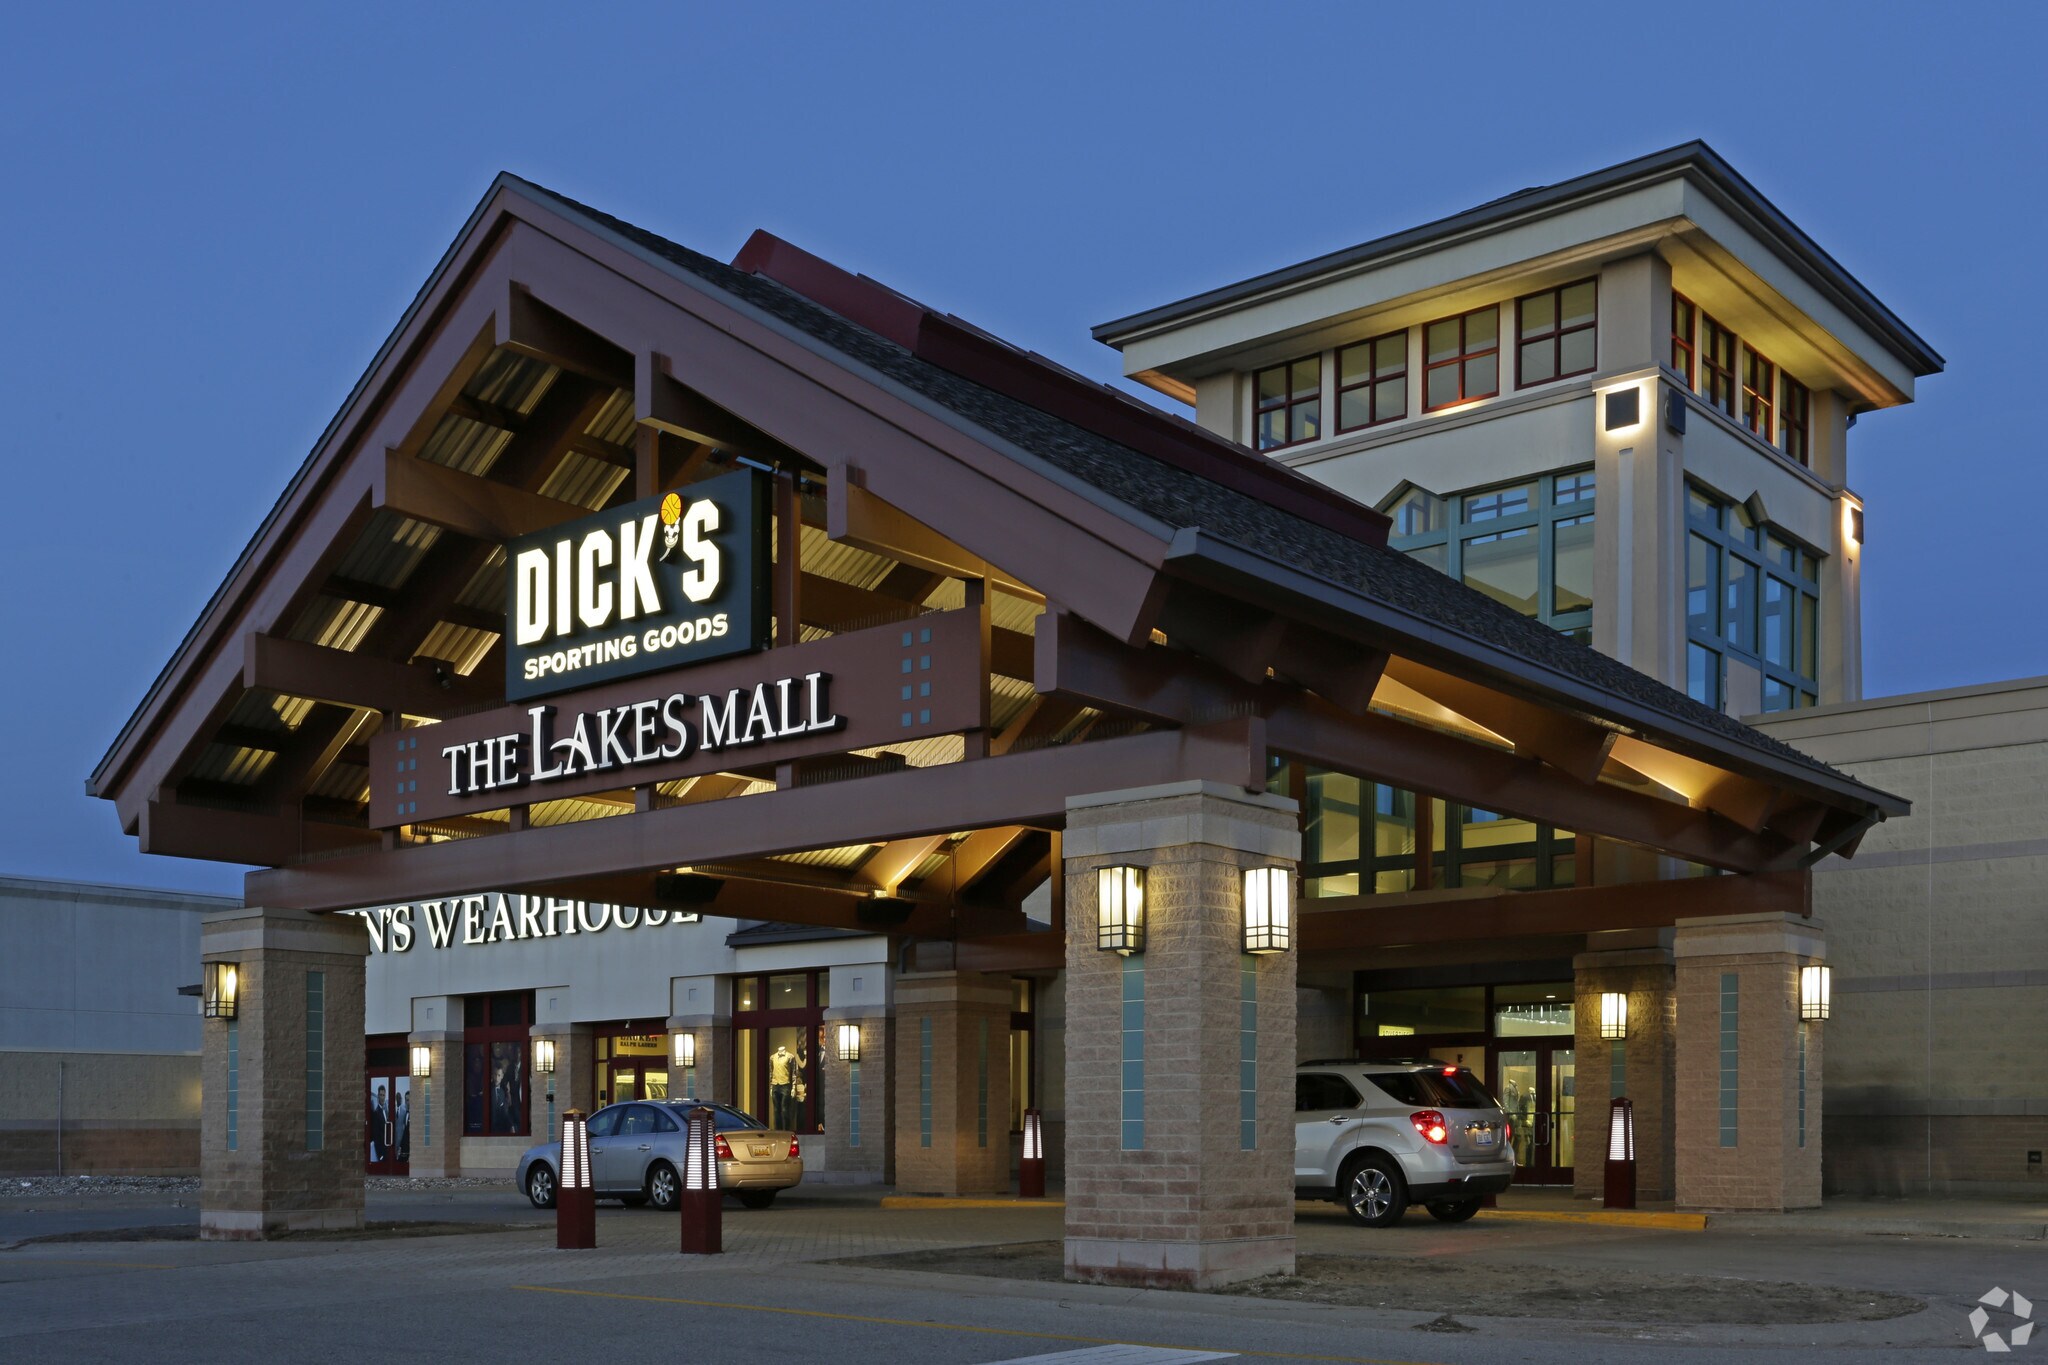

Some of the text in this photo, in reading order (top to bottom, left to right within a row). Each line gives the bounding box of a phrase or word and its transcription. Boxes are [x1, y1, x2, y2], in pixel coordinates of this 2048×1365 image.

[517, 493, 720, 646] DICK'S
[524, 613, 729, 680] SPORTING GOODS
[442, 671, 837, 795] THE LAKES MALL
[348, 893, 698, 952] N'S WEARHOU
